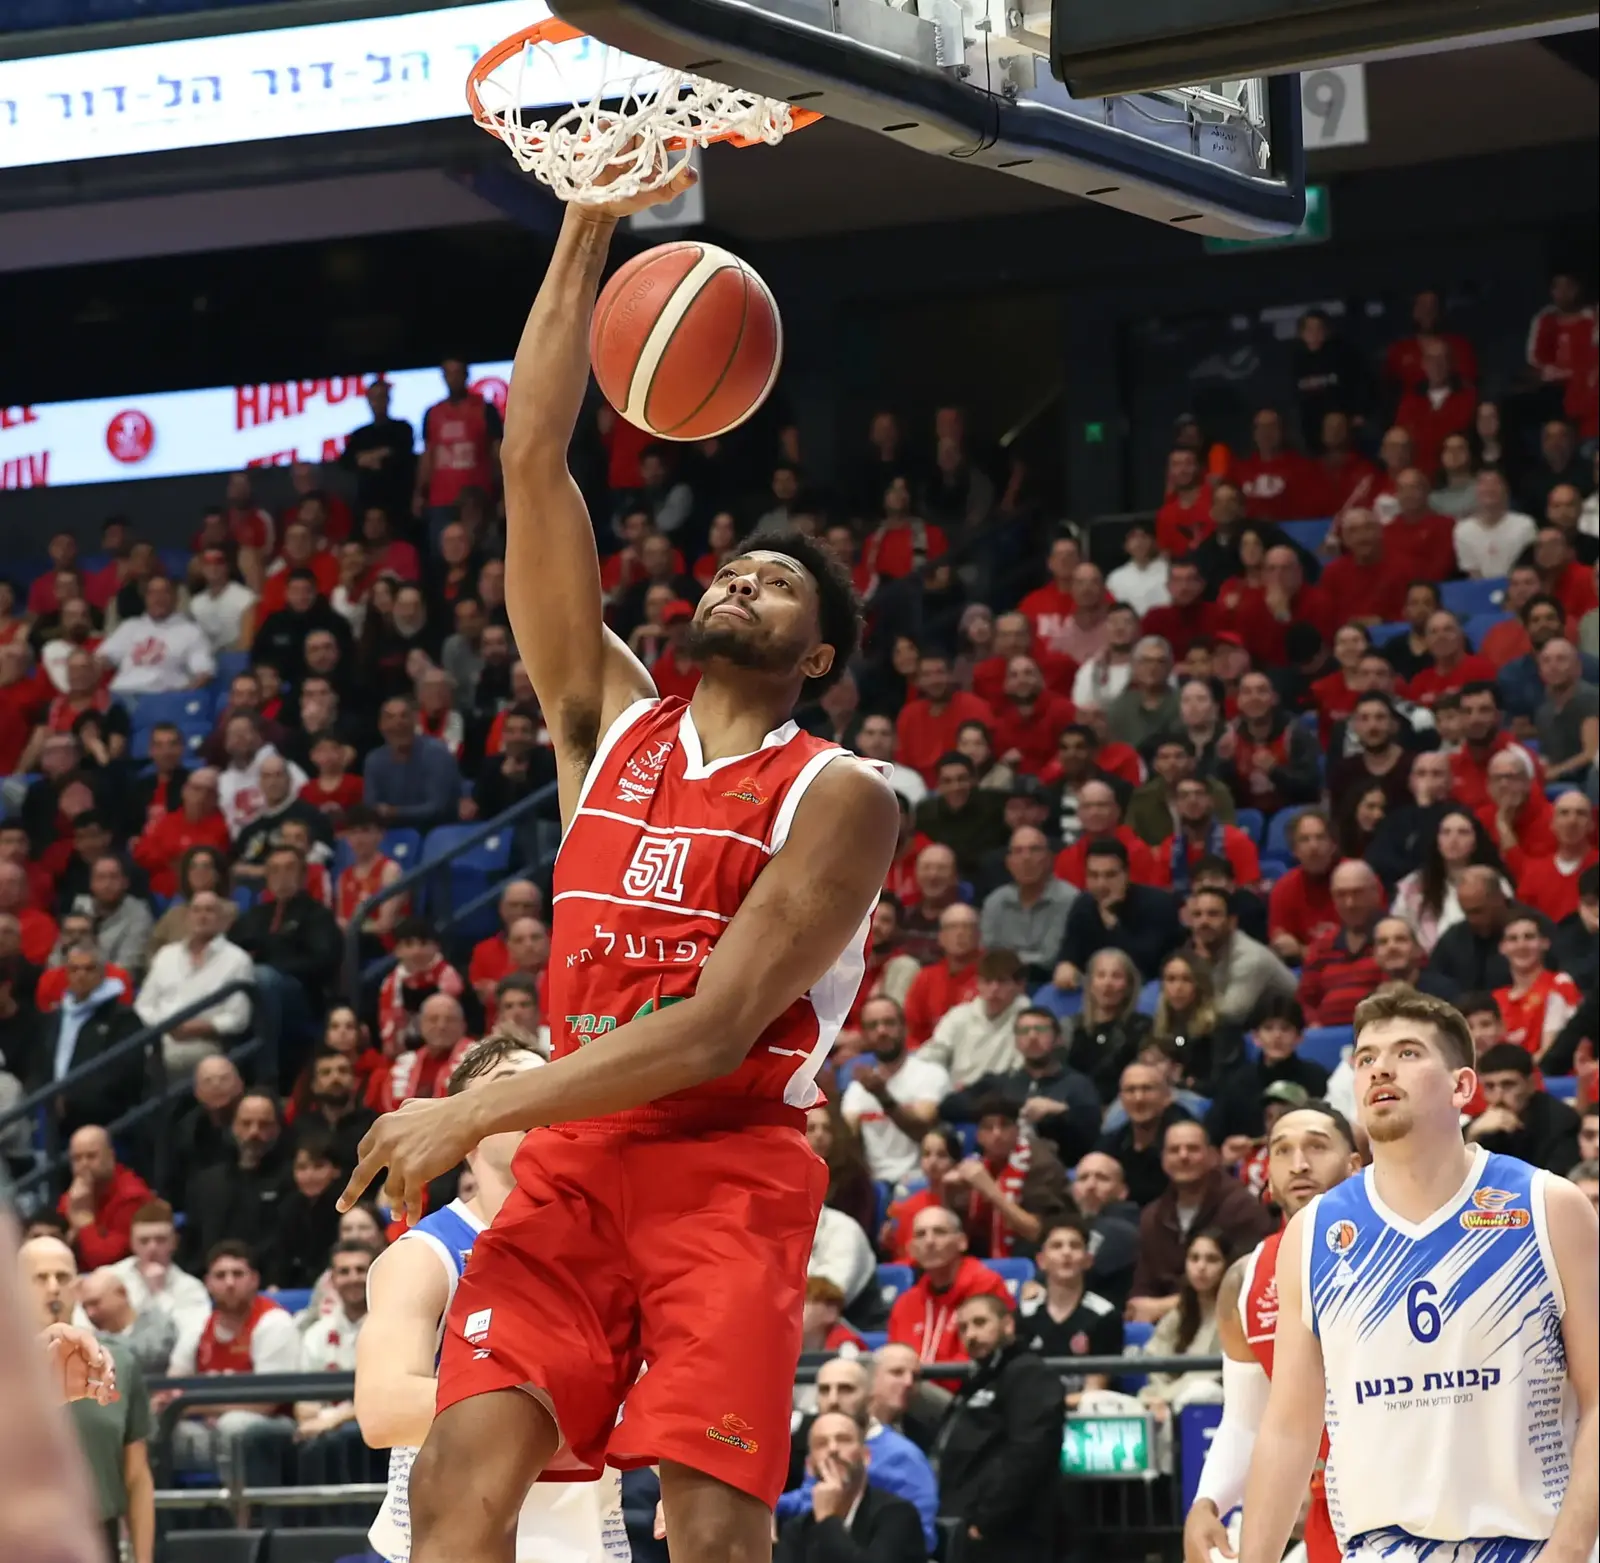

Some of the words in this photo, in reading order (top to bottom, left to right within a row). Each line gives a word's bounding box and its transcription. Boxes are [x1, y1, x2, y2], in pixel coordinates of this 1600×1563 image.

[622, 835, 691, 902] 51
[1407, 1280, 1442, 1343] 6
[1355, 1375, 1414, 1405] כנען
[1422, 1367, 1501, 1392] קבוצת
